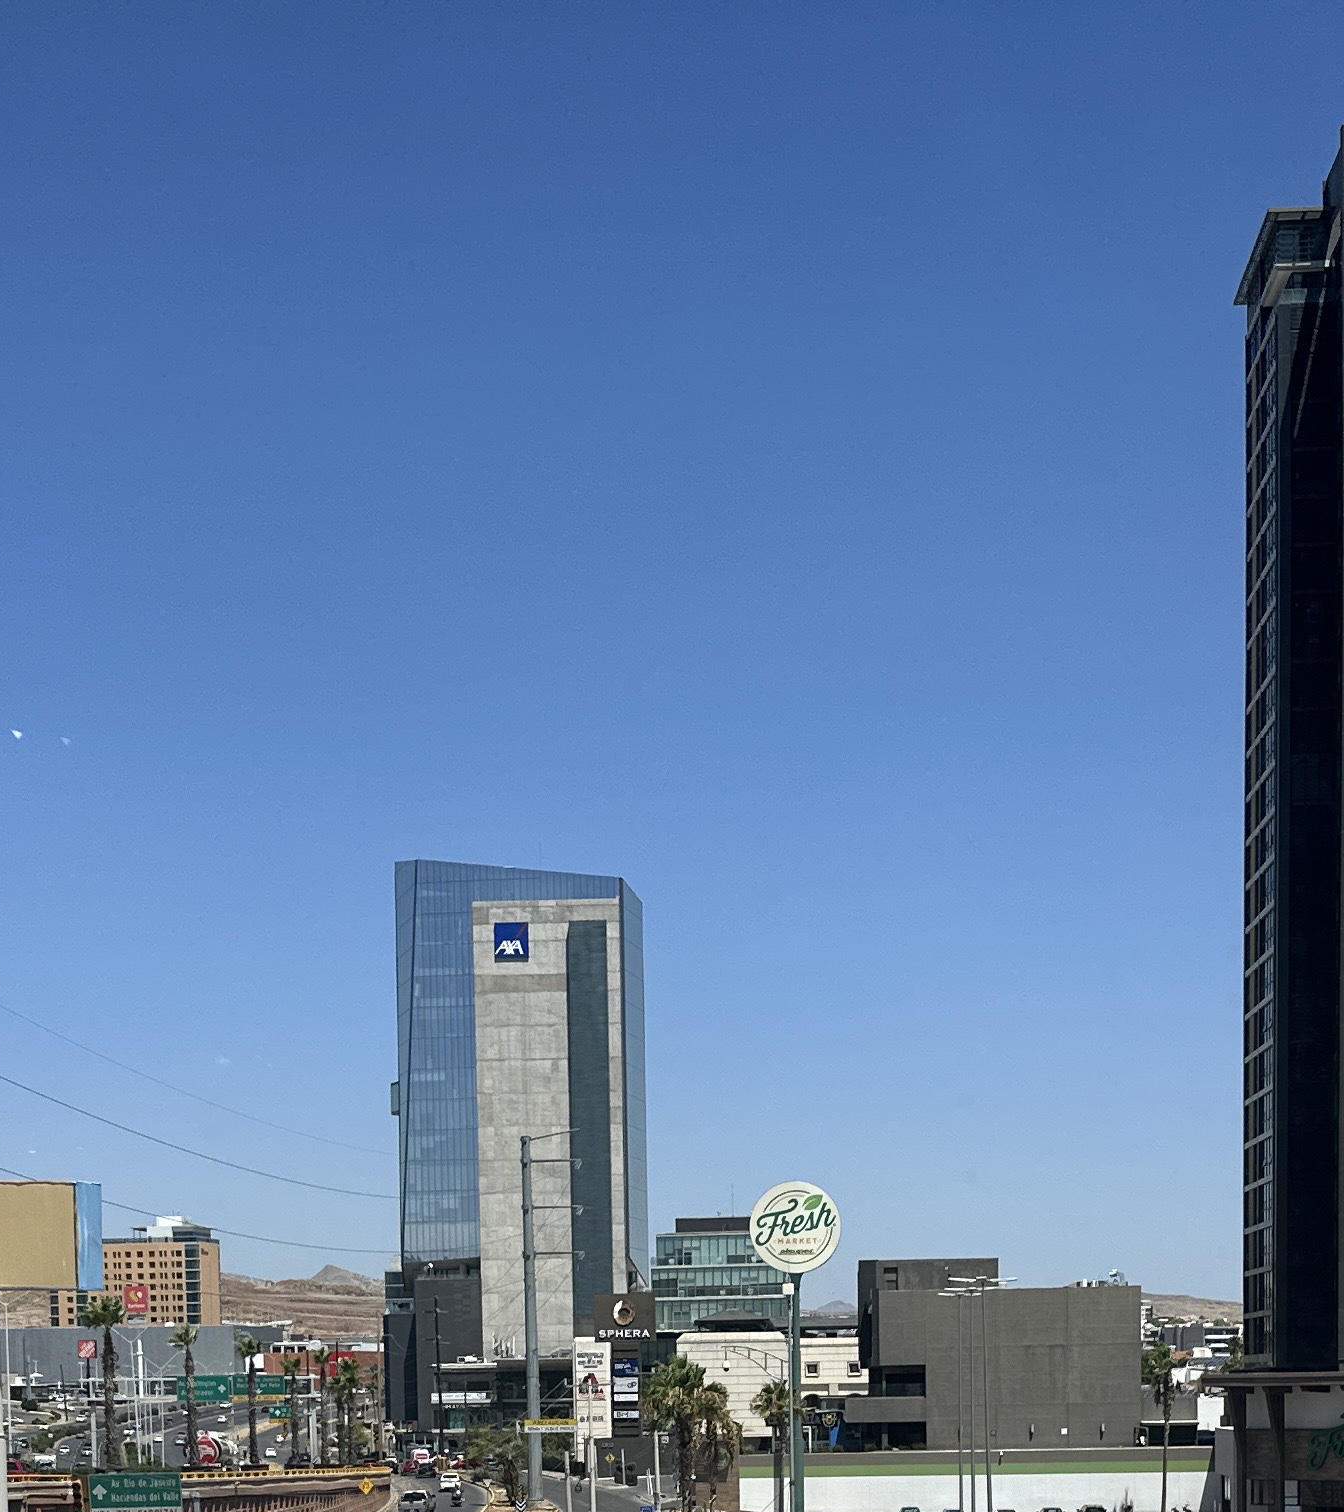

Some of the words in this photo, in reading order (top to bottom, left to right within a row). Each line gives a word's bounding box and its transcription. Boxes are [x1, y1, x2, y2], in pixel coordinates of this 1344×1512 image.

[494, 939, 524, 955] AXA
[755, 1198, 837, 1246] Fresh
[777, 1237, 817, 1245] MARKET
[598, 1329, 651, 1338] SPHERA
